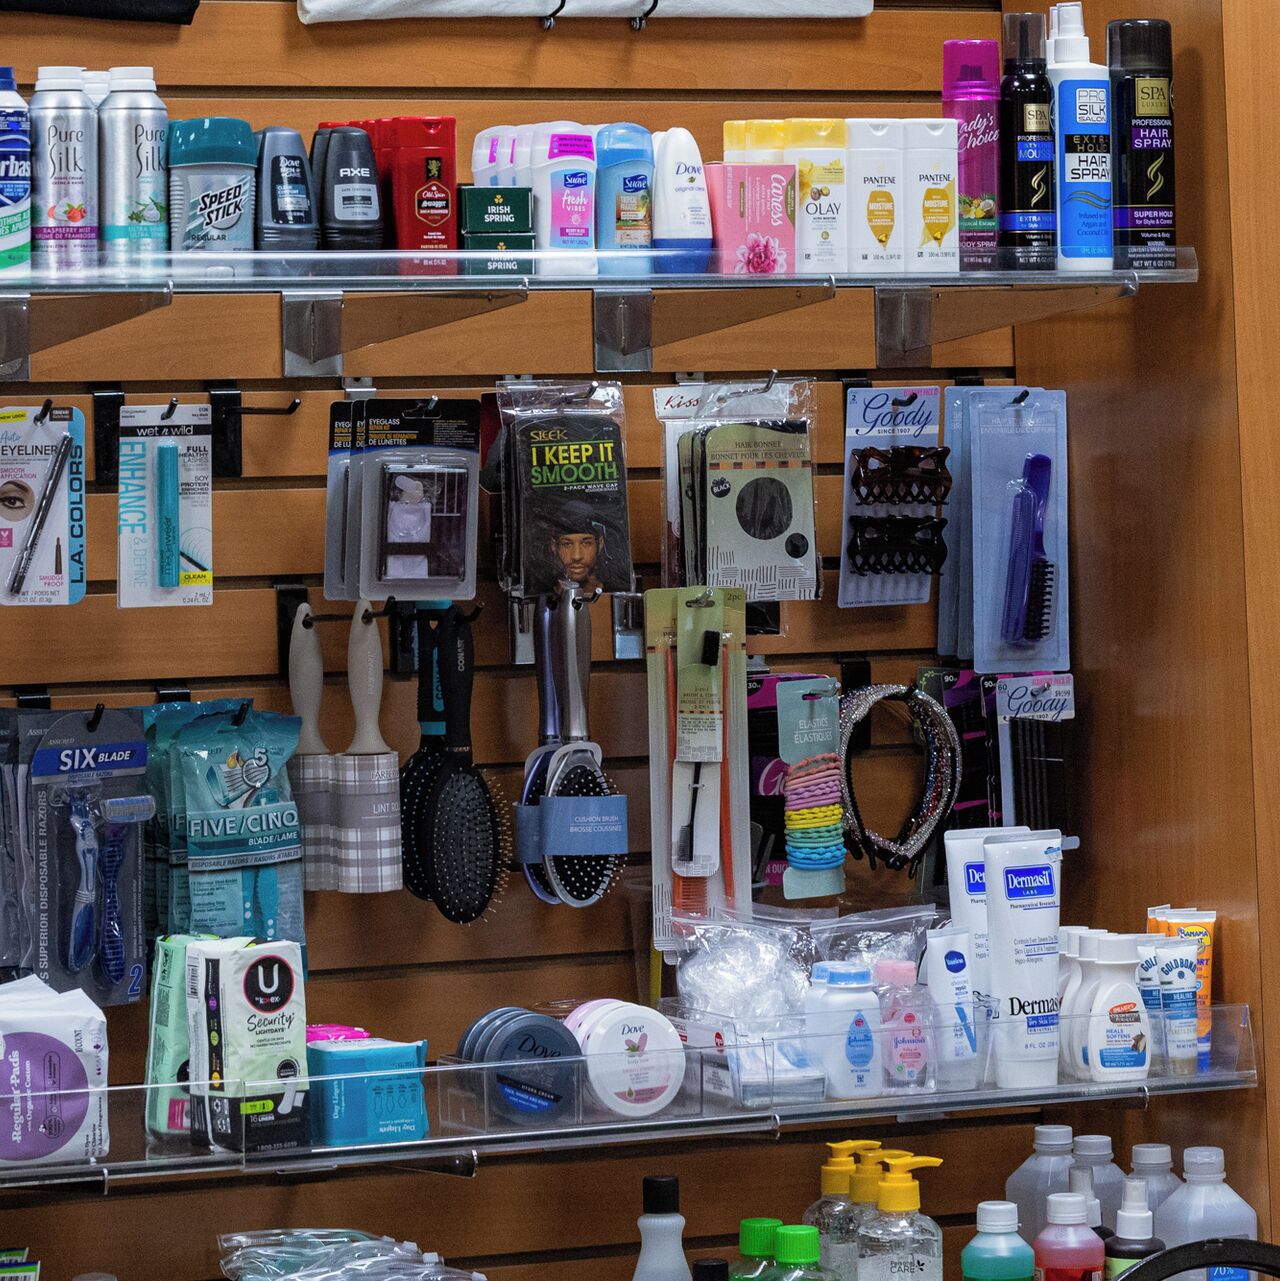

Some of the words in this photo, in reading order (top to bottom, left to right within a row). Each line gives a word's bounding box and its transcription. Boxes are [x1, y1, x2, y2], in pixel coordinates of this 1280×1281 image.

[1140, 87, 1166, 100] SPA
[1027, 109, 1047, 120] SPA
[48, 125, 83, 145] Pure
[135, 124, 165, 144] Pure
[1140, 129, 1168, 137] HAIR
[1134, 139, 1172, 148] SPRAY
[50, 145, 85, 178] Silk
[676, 162, 702, 175] Dove
[1079, 156, 1107, 166] HAIR
[340, 168, 369, 177] AXE
[919, 174, 951, 182] PANTENE
[199, 185, 242, 212] SPEED
[770, 174, 786, 226] Caress
[205, 202, 243, 226] STICK
[488, 206, 510, 214] IRISH
[806, 202, 841, 216] OLAY
[484, 214, 514, 222] SPRING
[488, 261, 517, 269] SPRING
[856, 393, 934, 436] Goody
[532, 448, 536, 465] I
[545, 445, 593, 464] KEEP
[600, 443, 614, 461] IT
[531, 463, 616, 482] SMOOTH
[119, 441, 146, 535] ENHANCE
[799, 719, 828, 729] ELASTICS
[60, 749, 96, 770] SIX
[98, 751, 131, 762] BLADE
[373, 804, 390, 813] LINT
[39, 836, 48, 913] DISPOSABLE
[1007, 871, 1050, 888] Dermasil
[39, 916, 48, 969] SUPERIOR
[127, 964, 143, 993] 2
[621, 1024, 644, 1035] Dove
